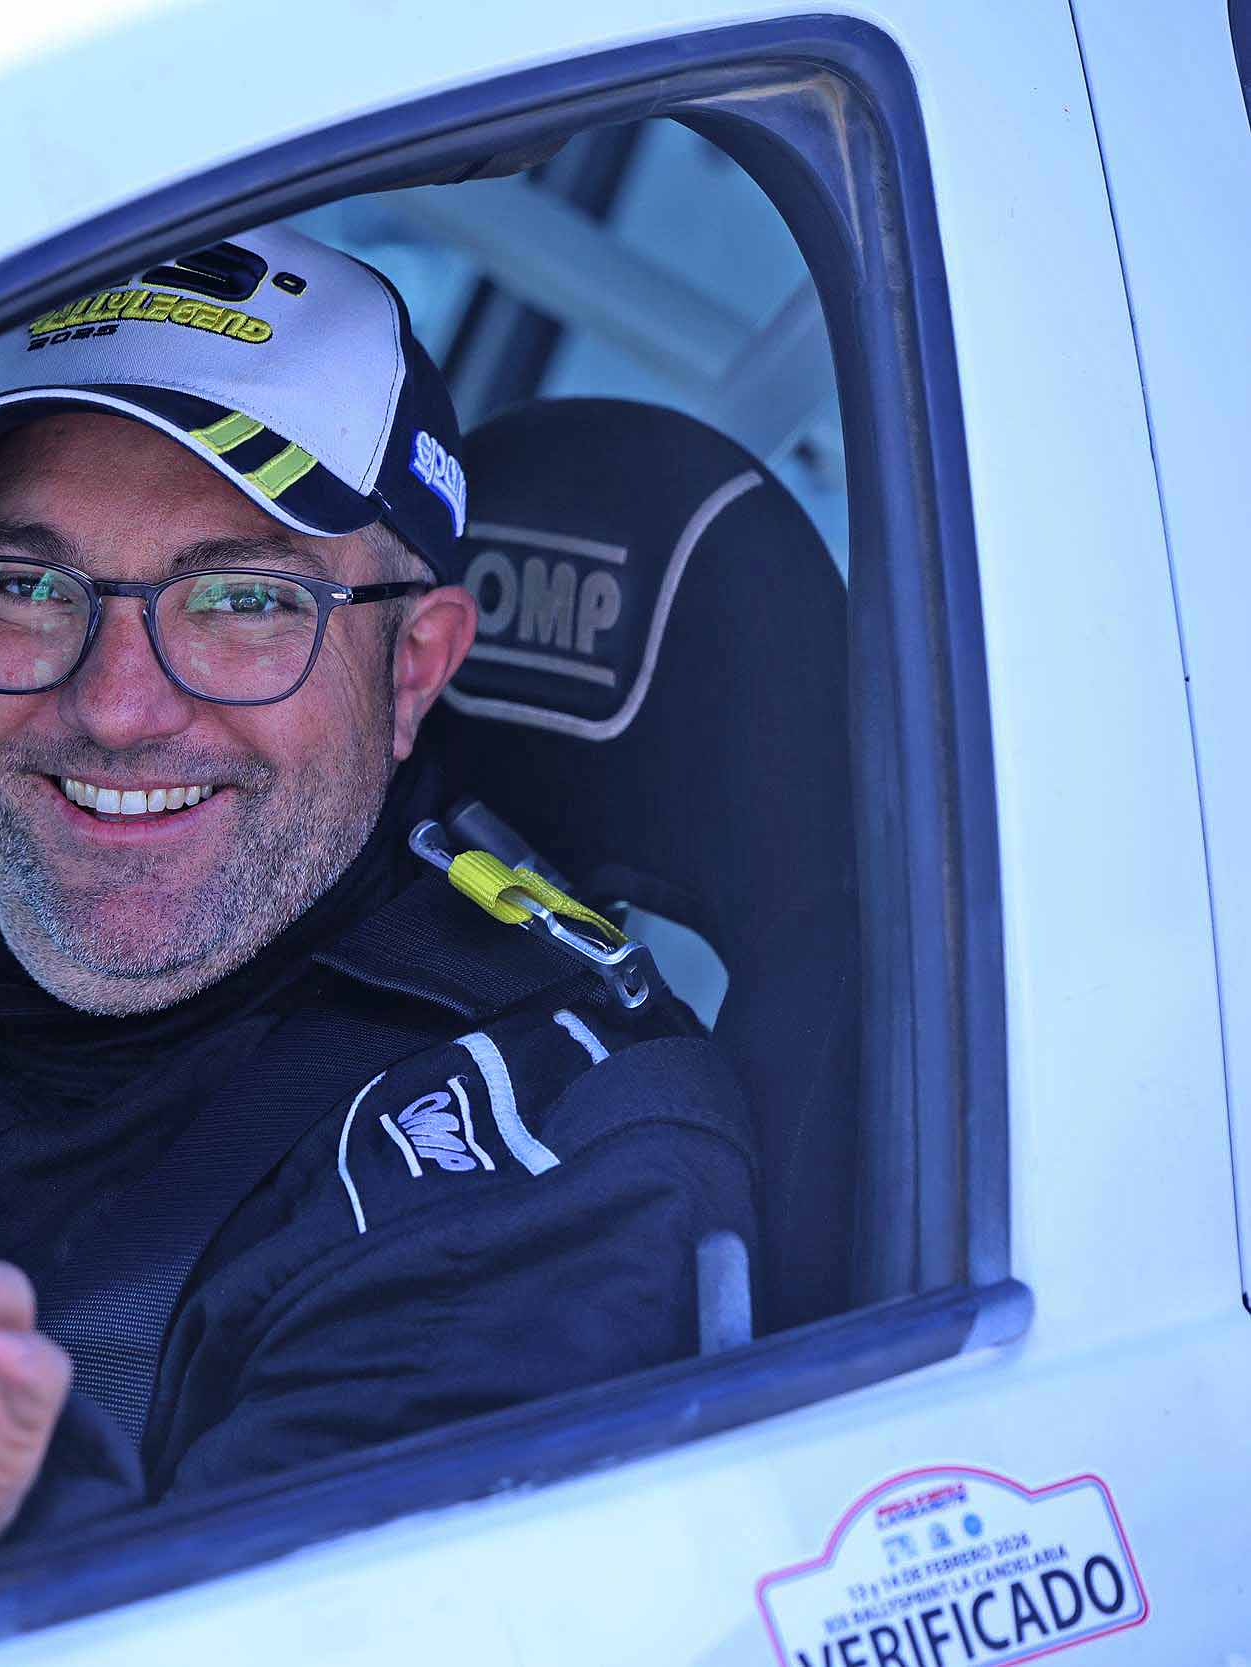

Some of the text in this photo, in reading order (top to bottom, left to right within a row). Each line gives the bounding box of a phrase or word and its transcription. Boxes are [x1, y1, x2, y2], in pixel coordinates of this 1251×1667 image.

[26, 323, 120, 352] 2025
[463, 550, 622, 653] OMP
[924, 1542, 992, 1577] FEBRERO
[973, 1543, 1070, 1586] CANDELARIA
